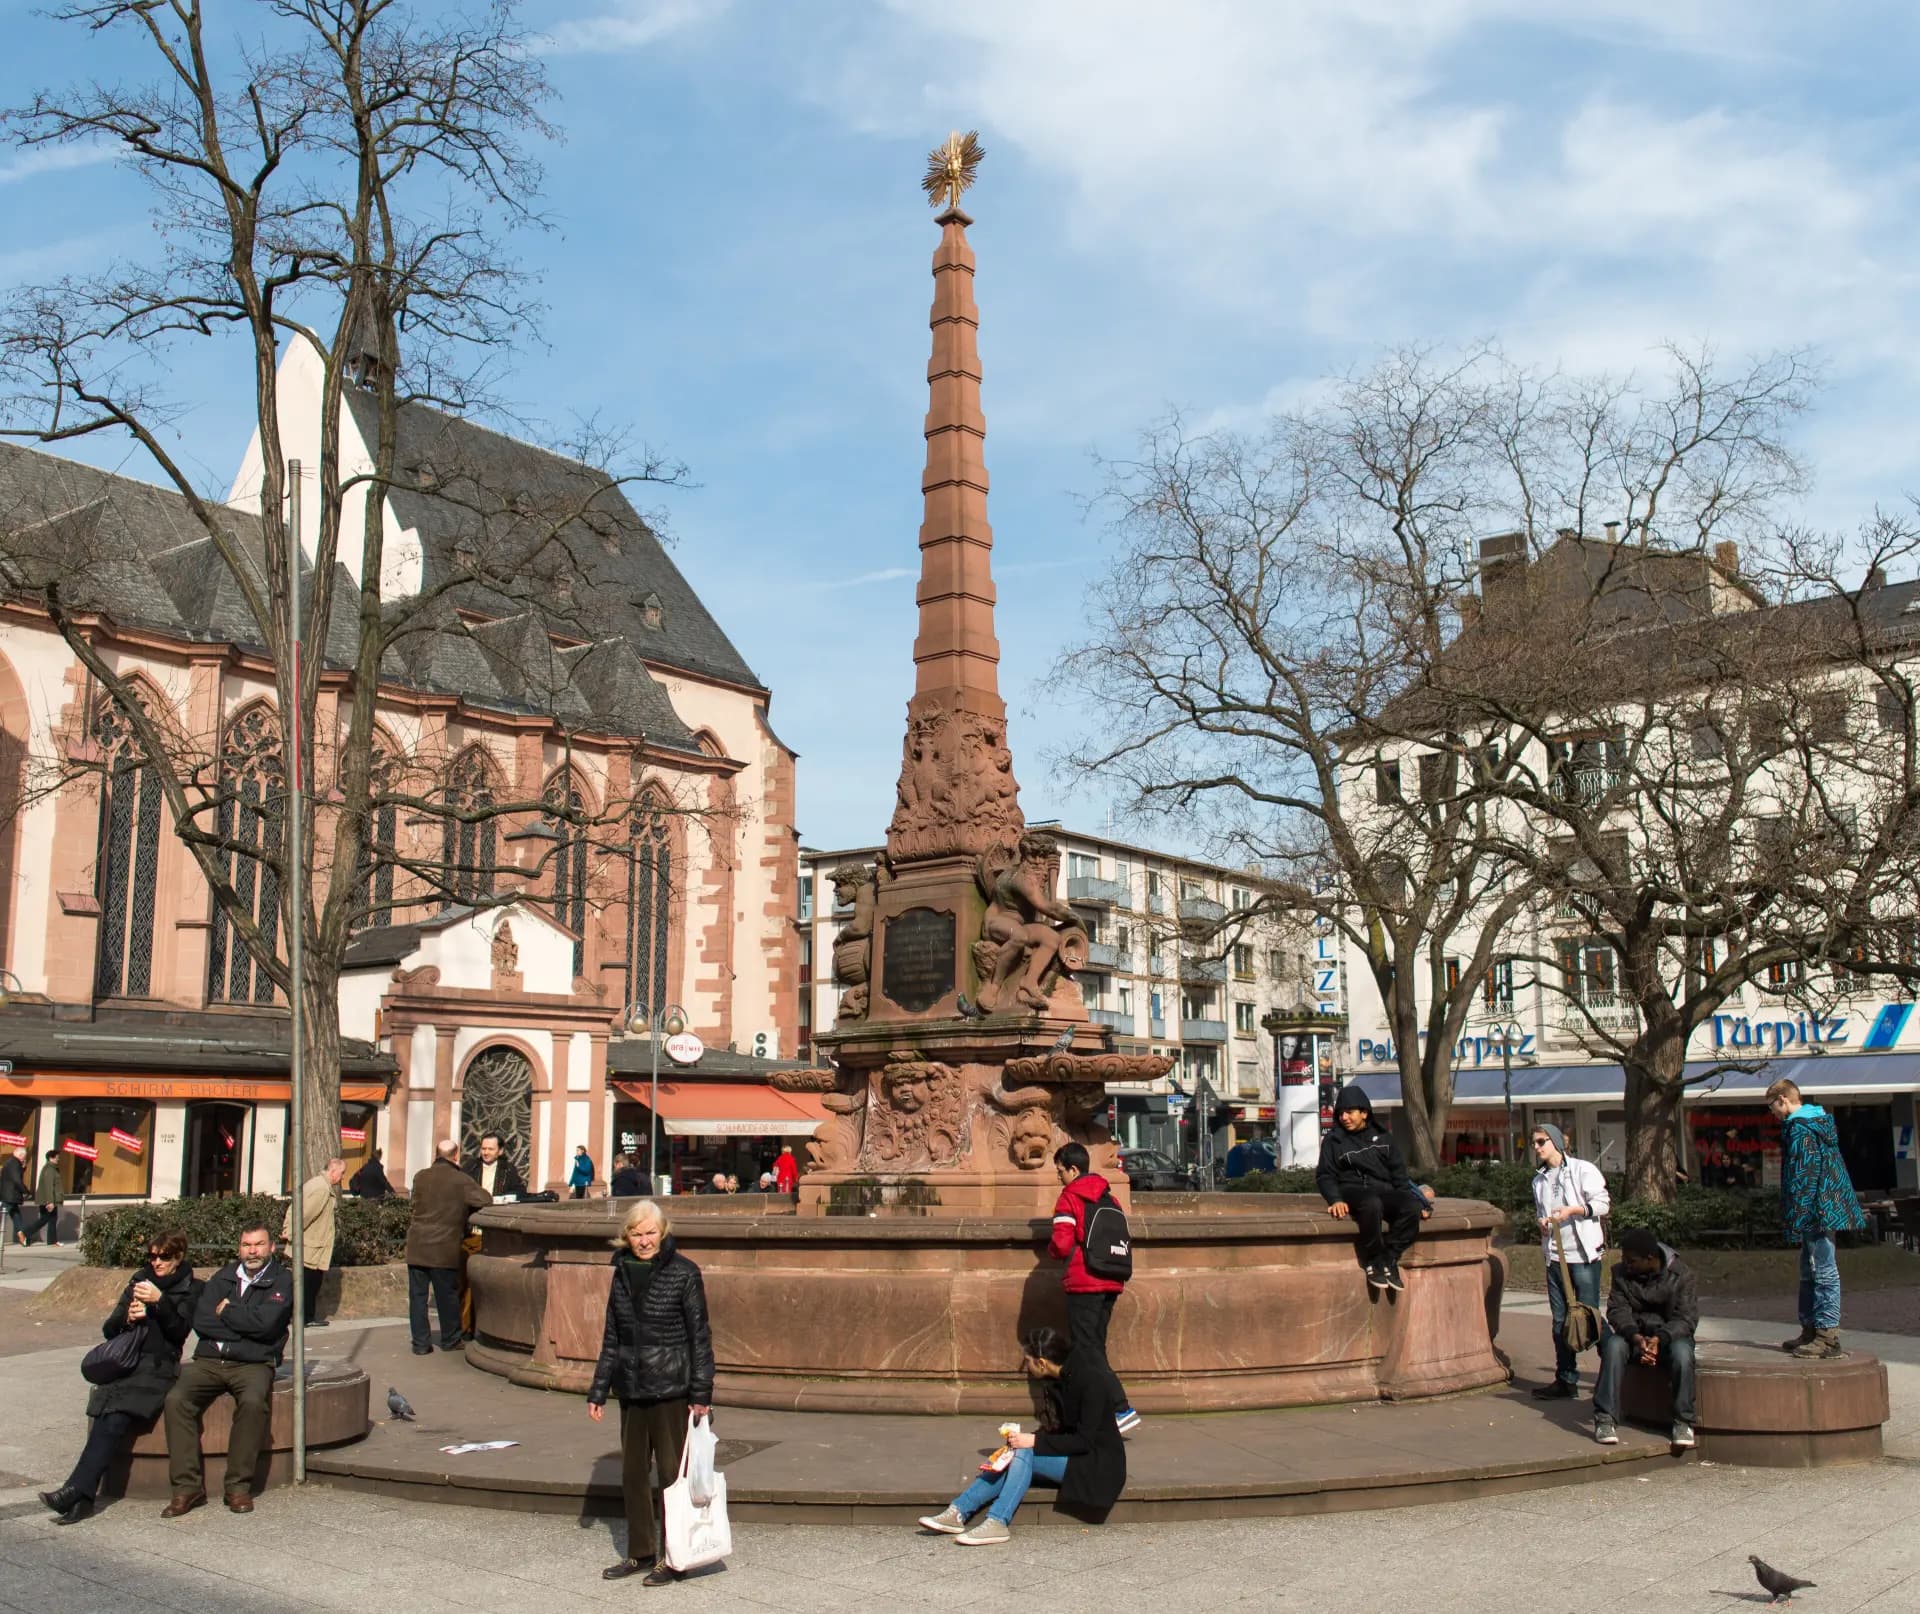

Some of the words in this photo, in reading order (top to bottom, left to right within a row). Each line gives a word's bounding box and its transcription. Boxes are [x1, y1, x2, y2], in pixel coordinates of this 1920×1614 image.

[1712, 1010, 1850, 1056] Türpitz
[1358, 1037, 1399, 1063] Pel
[106, 1081, 173, 1097] SCHIRM
[621, 1131, 648, 1146] Schuh
